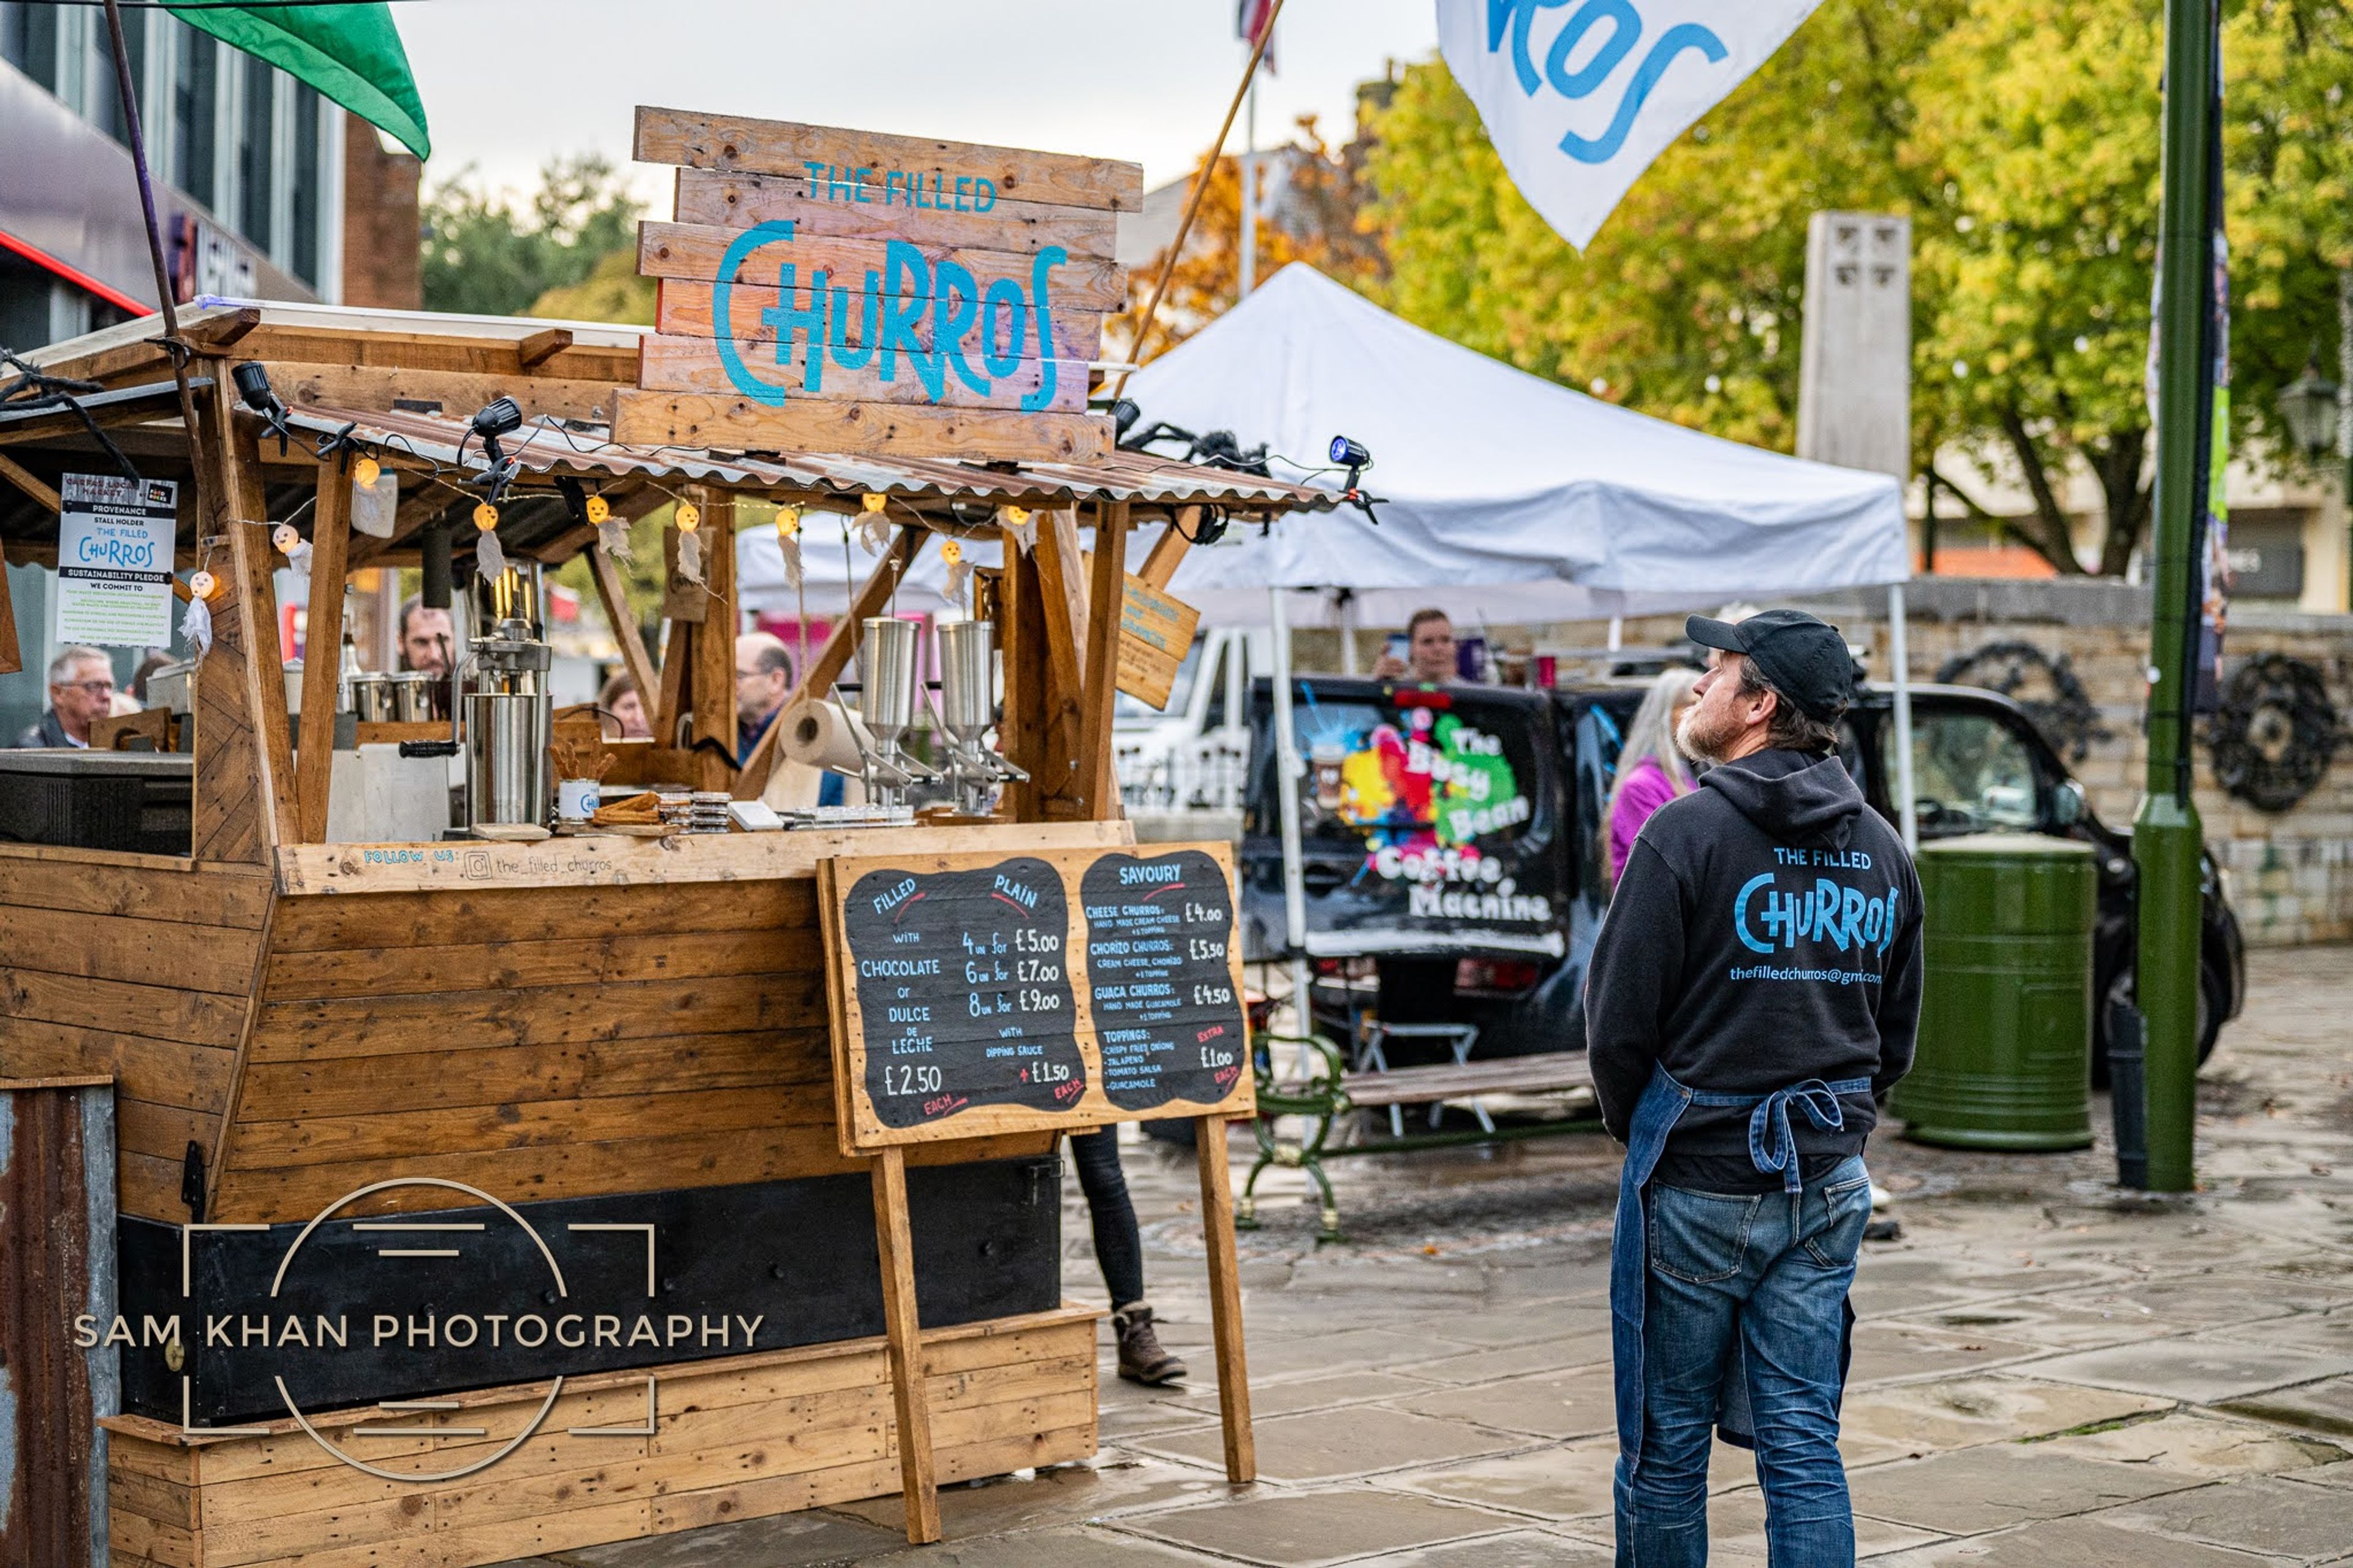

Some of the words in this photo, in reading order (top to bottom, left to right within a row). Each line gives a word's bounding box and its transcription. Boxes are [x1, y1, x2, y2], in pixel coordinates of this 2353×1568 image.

[804, 161, 873, 204] THE
[885, 170, 996, 213] FILLED
[713, 220, 1067, 414] CHURROS
[93, 505, 147, 516] PROVENANCE
[116, 518, 145, 527] HOLDER
[97, 527, 116, 537] THE
[120, 529, 148, 539] FILLED
[68, 569, 134, 581] SUSTAINABILITY
[134, 574, 164, 582] PLEDGE
[1450, 726, 1502, 756] The
[1448, 795, 1531, 840] Bean
[364, 850, 423, 865] FOLLOW
[1774, 847, 1808, 865] THE
[1813, 850, 1871, 870] FILLED
[1120, 863, 1182, 885] SAVOURY
[1085, 906, 1119, 919] CHEESE
[1185, 902, 1223, 923] £4.00
[1094, 919, 1113, 929] HAND
[1116, 918, 1134, 927] MADE
[1134, 917, 1156, 926] CREAM
[1156, 915, 1181, 924] CHEESE
[1735, 872, 1898, 958] CHURROS
[991, 932, 1008, 955] for
[1015, 929, 1059, 952] £5.00
[1189, 938, 1225, 961] £5.50
[861, 960, 941, 978] CHOCOLATE
[995, 960, 1009, 982] for
[1017, 959, 1059, 982] £7.00
[1097, 958, 1122, 969] CREAM
[997, 993, 1012, 1013] for
[1019, 988, 1060, 1012] £9.00
[1094, 985, 1127, 1000] GUACA
[1194, 985, 1231, 1005] £4.50
[1104, 1002, 1123, 1010] HAND
[1146, 998, 1182, 1009] GUACAMOLE
[889, 1007, 931, 1023] DULCE
[906, 1027, 917, 1037] DE
[1197, 1025, 1224, 1043] EXTRA
[892, 1037, 933, 1055] LECHE
[1017, 1045, 1044, 1056] SAUCE
[1200, 1045, 1233, 1068] £1.00
[1032, 1061, 1070, 1083] £1.50
[1139, 1064, 1162, 1074] SALSA
[1214, 1066, 1240, 1084] EACH
[885, 1065, 942, 1096] £2.50
[1054, 1078, 1081, 1100] EACH
[923, 1093, 953, 1116] EACH
